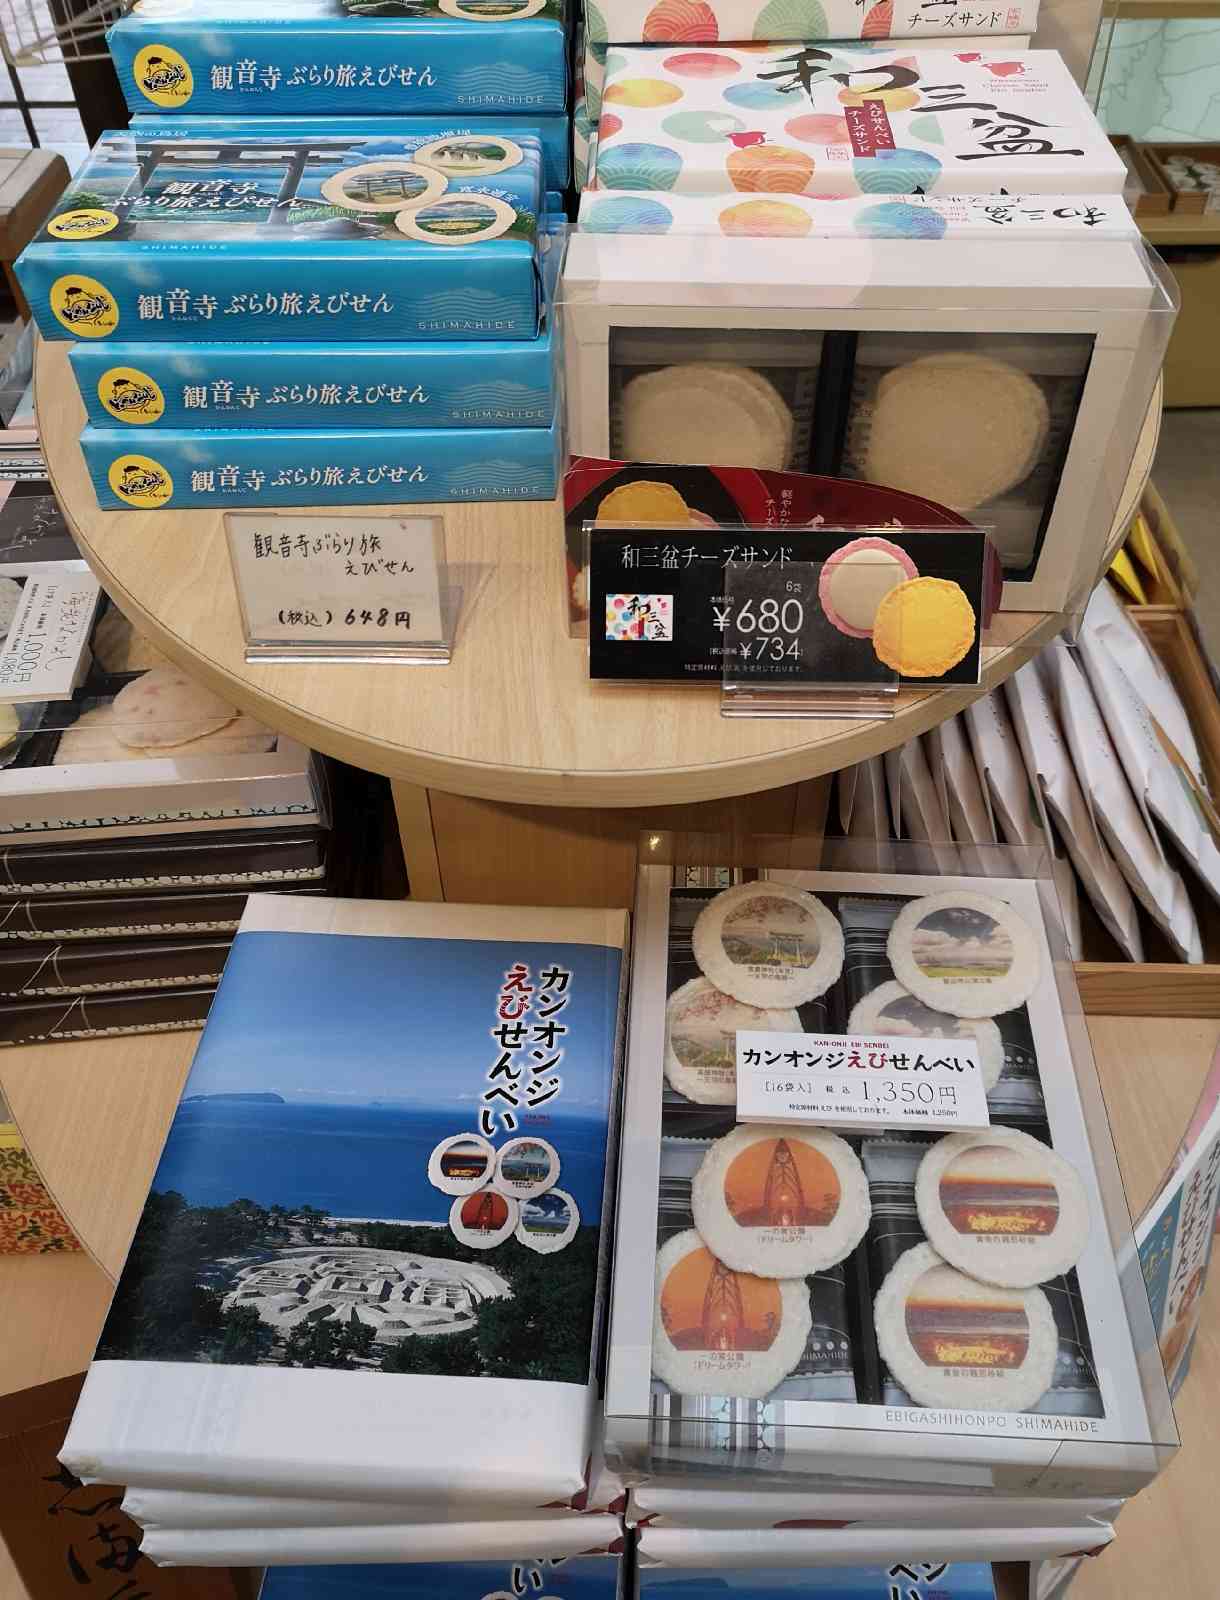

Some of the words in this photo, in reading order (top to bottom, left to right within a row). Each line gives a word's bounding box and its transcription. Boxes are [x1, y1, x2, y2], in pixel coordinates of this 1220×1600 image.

[908, 12, 1001, 28] チーズサンド
[457, 95, 544, 104] SHIMAHIDE
[848, 111, 869, 152] チーズサンド
[869, 103, 891, 145] えびせんべい
[162, 179, 259, 195] 観音寺
[417, 320, 515, 329] SHIMAHIDE
[451, 410, 545, 418] SHIMAHIDE
[450, 487, 540, 495] SHIMAHIDE
[253, 532, 382, 558] 観音寺ぶらり旅
[345, 559, 415, 575] えびせん
[621, 544, 793, 569] 和三盆チーズサンド
[344, 608, 411, 630] 648円
[712, 599, 804, 633] ¥680
[526, 967, 571, 1107] カンオンジ
[481, 965, 533, 1136] えびせんべい
[743, 1050, 975, 1072] カンオンジえびせんべい
[863, 1081, 957, 1104] 1,350円
[885, 1411, 1007, 1428] EBIGASHIHONPO
[1015, 1416, 1099, 1433] SHIMAHIDE
